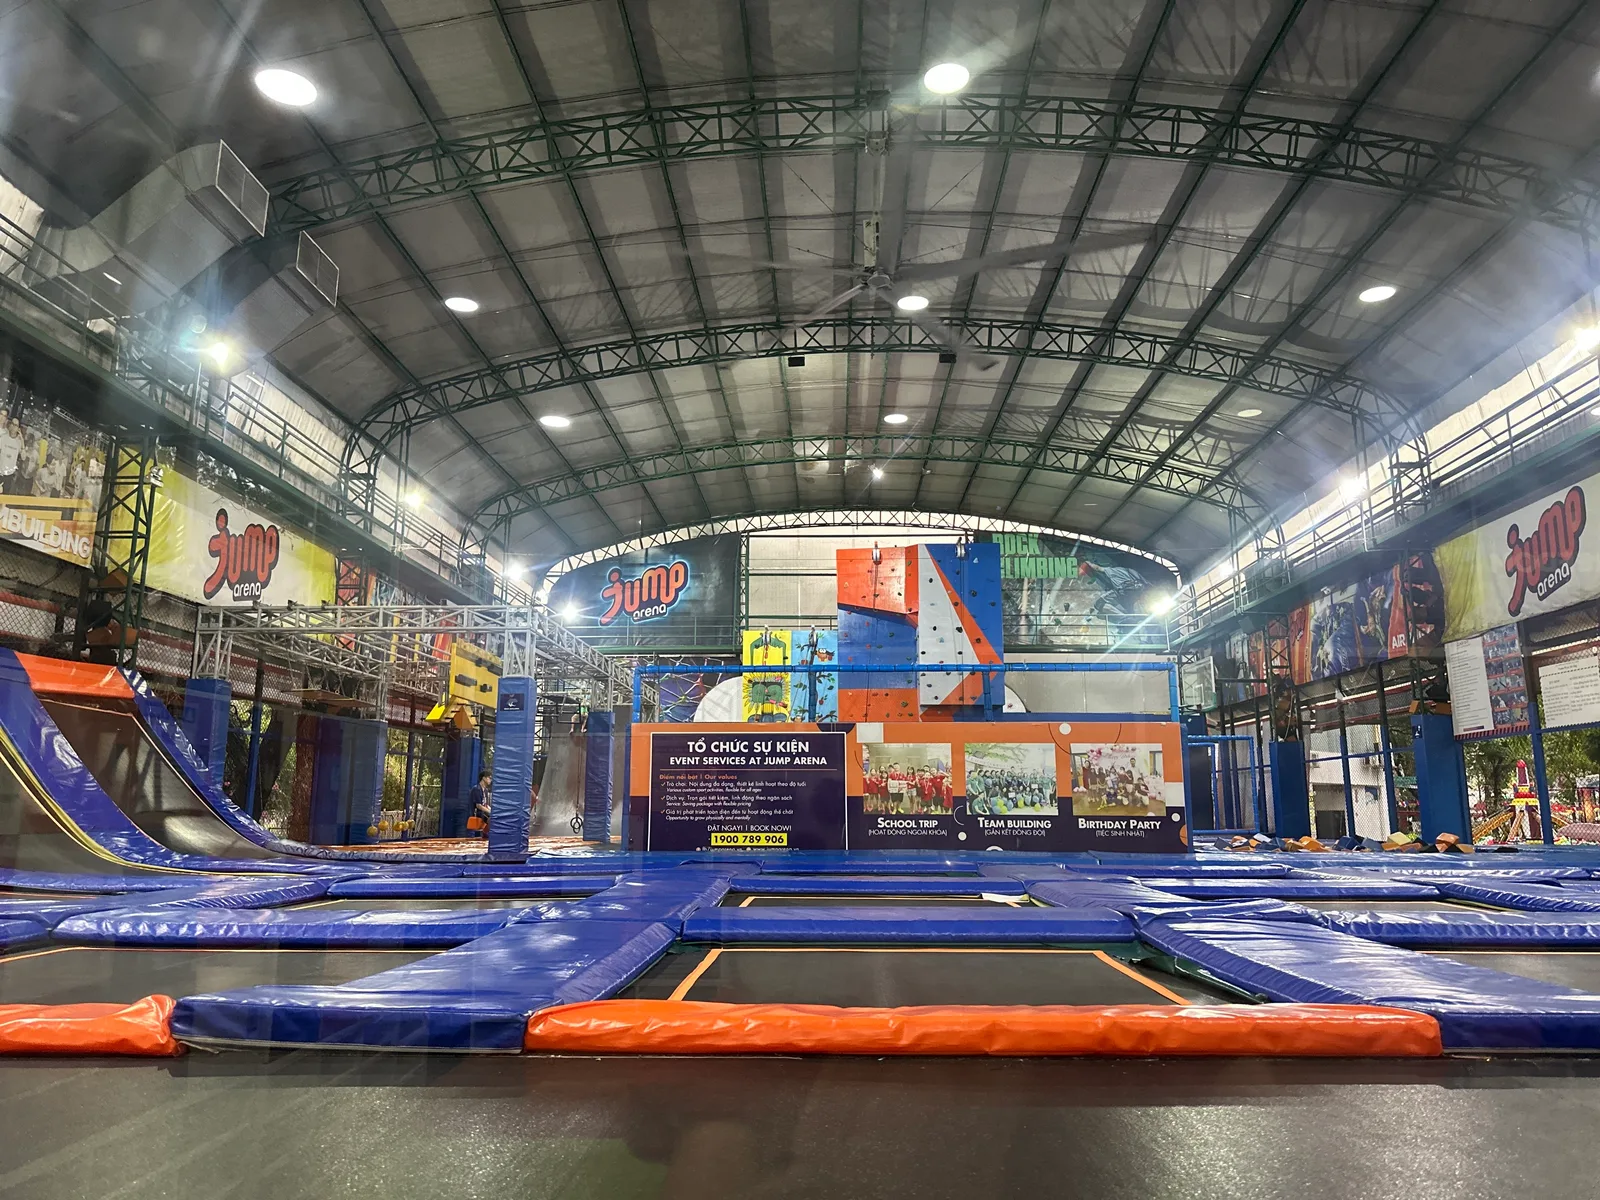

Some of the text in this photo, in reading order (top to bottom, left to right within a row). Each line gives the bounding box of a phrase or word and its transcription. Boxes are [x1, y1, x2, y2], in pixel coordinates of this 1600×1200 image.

[204, 509, 278, 598] jump
[1506, 487, 1585, 615] jump
[1537, 562, 1570, 596] arena
[234, 582, 260, 597] arena
[600, 561, 686, 625] jump
[633, 604, 666, 620] arena
[688, 737, 810, 755] TỔ CHỨC SỰ KIỆN
[670, 757, 828, 765] EVENT SERVICES AT JUMP ARENA
[714, 835, 784, 843] 1900 789 906
